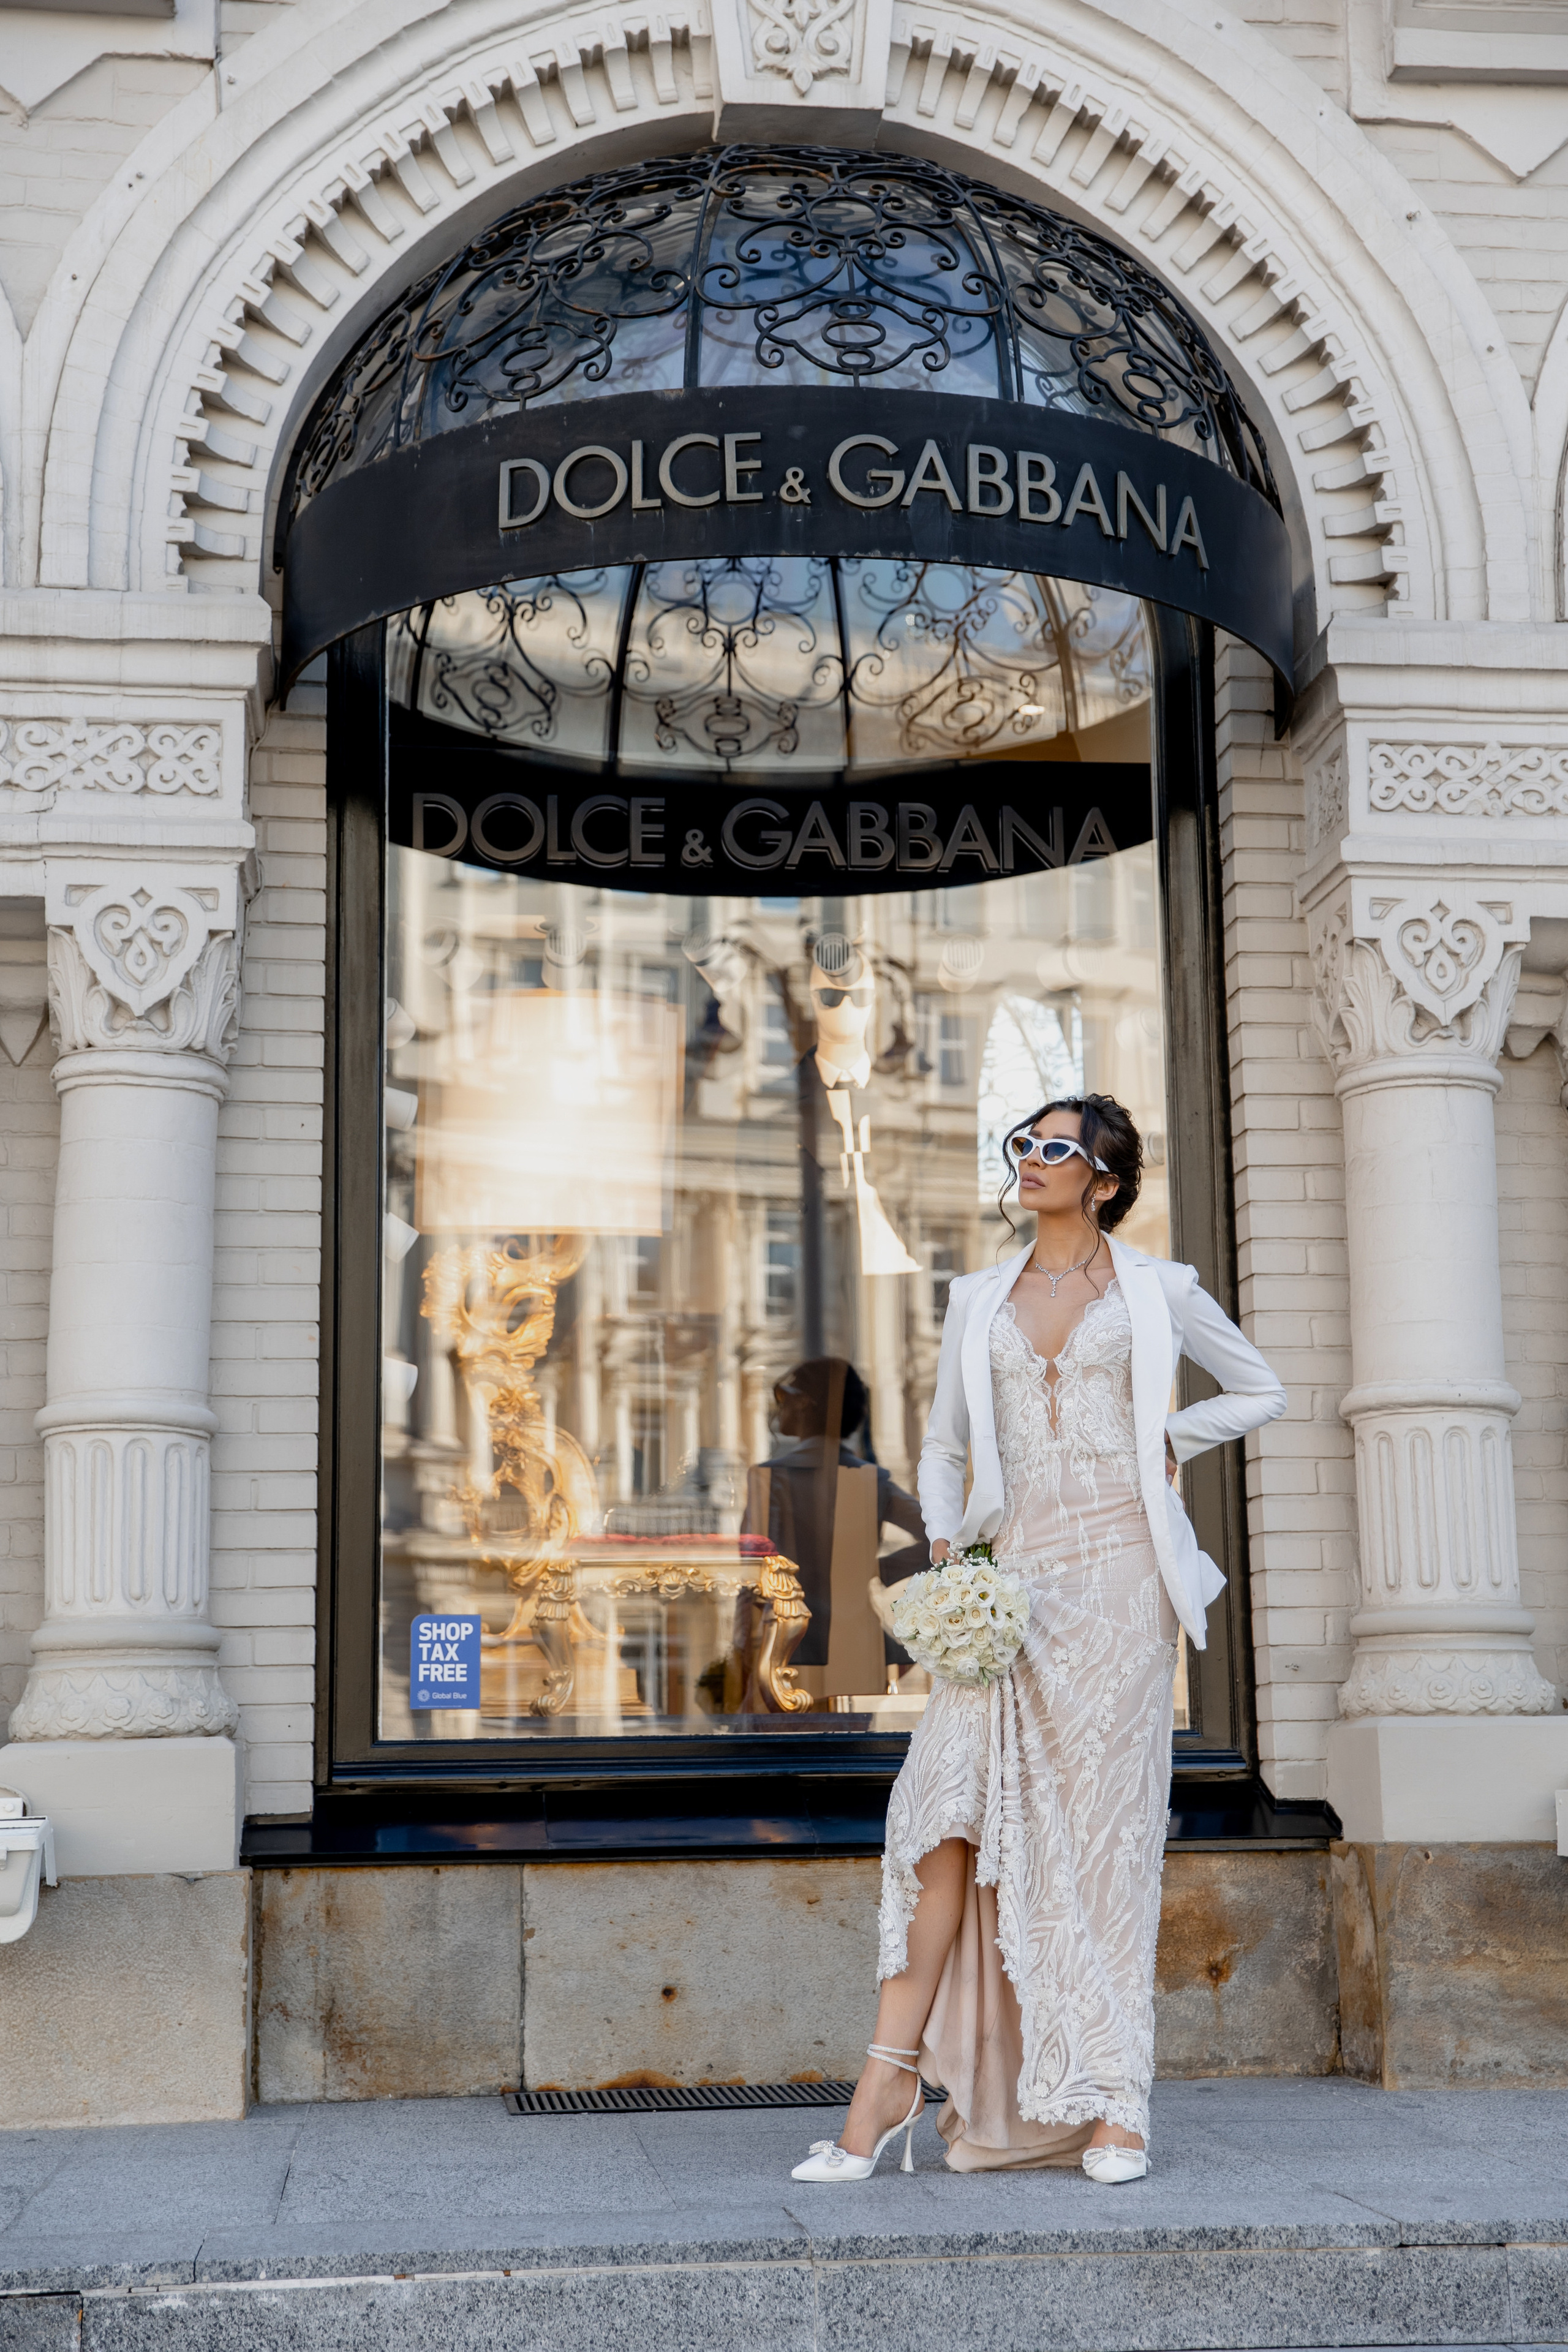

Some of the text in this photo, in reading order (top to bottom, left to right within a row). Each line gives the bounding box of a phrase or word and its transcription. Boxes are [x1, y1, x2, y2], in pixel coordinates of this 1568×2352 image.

[499, 432, 1209, 570] DOLCE & GABBANA
[412, 793, 1120, 873] DOLCE & GABBANA
[419, 1623, 473, 1641] SHOP
[418, 1643, 459, 1661] TAX
[418, 1664, 467, 1682] FREE
